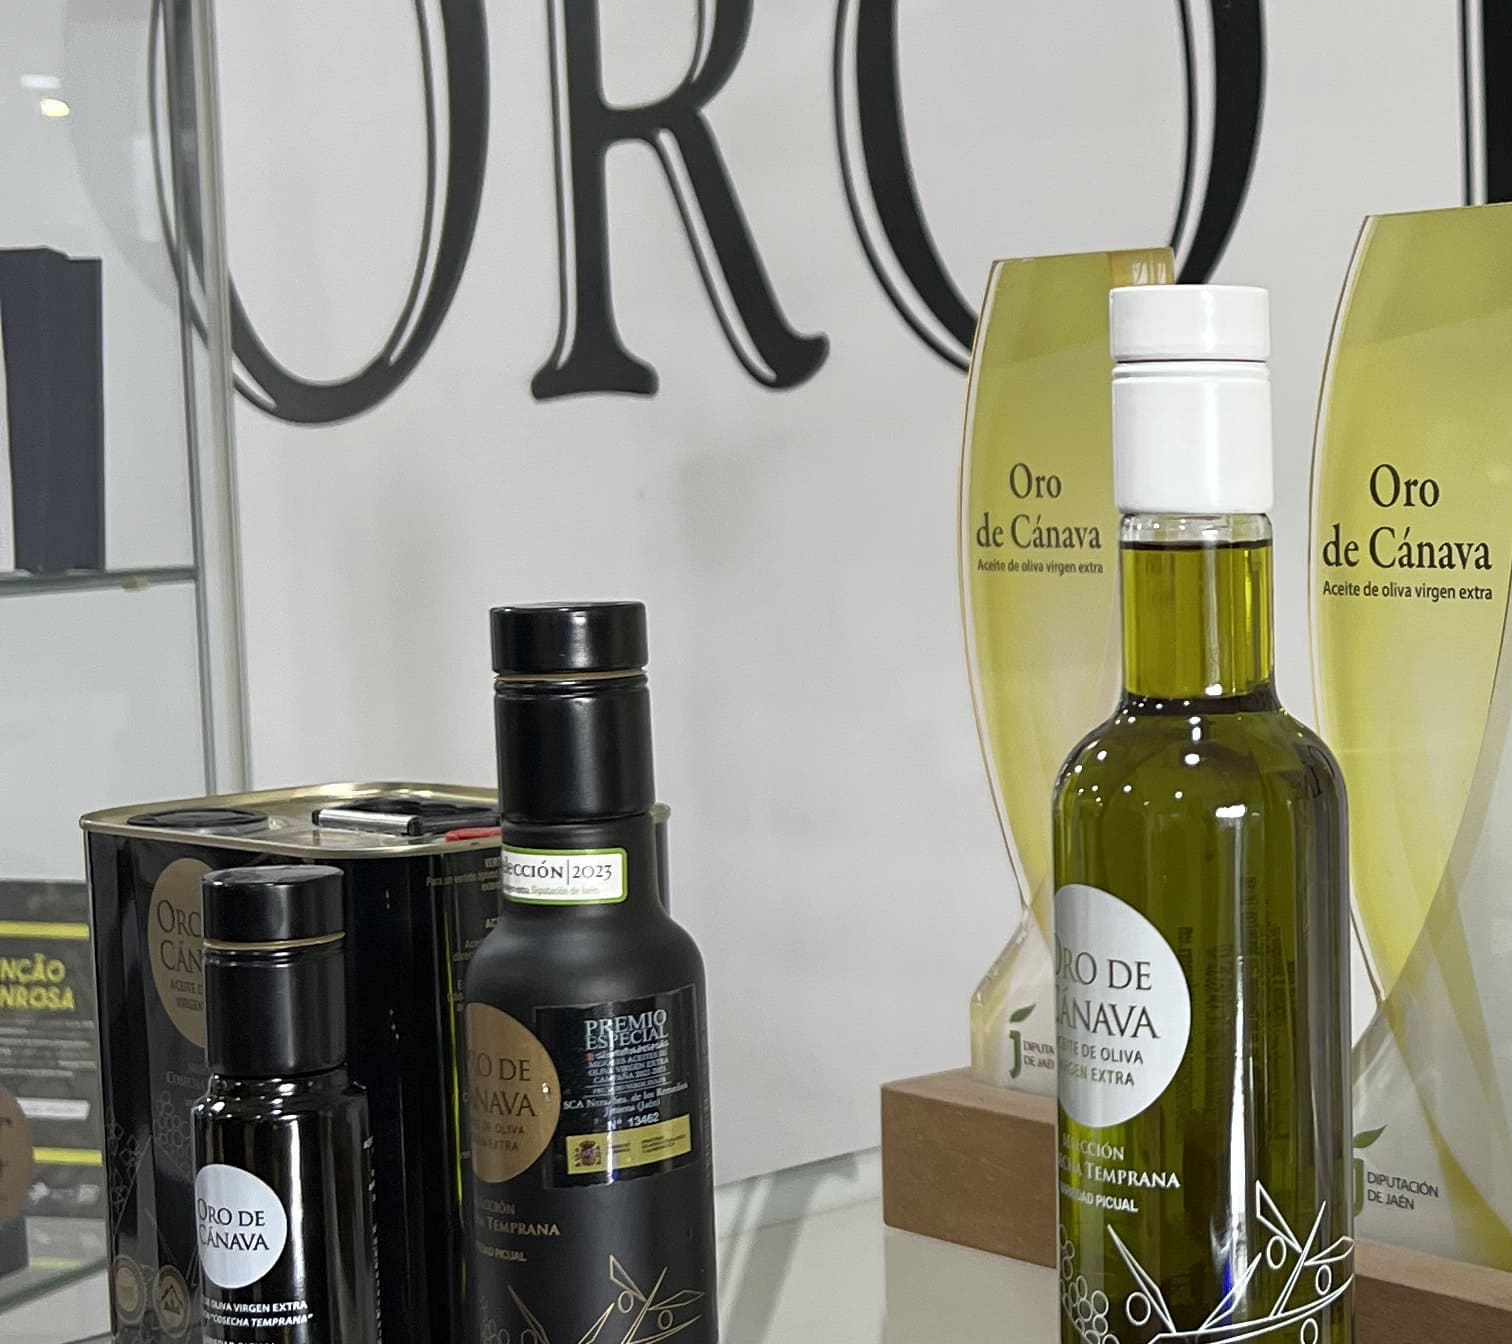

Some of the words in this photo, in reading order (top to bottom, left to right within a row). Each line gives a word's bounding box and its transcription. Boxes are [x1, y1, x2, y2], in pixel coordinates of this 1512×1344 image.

[1009, 462, 1062, 499] Oro
[1369, 463, 1440, 508] Oro
[976, 512, 1004, 548] de
[1011, 513, 1102, 549] Cánava
[1322, 522, 1360, 568] de
[1369, 526, 1493, 571] Cánava
[978, 558, 1006, 572] Aceite
[1008, 559, 1019, 572] de
[1021, 560, 1044, 573] oliva
[1046, 560, 1076, 577] virgen
[1078, 562, 1103, 574] extra
[1323, 580, 1360, 597] Aceite
[1363, 581, 1379, 597] de
[1381, 581, 1412, 598] oliva
[1414, 582, 1456, 603] virgen
[1459, 585, 1493, 600] extra
[1107, 959, 1153, 991] DE
[584, 1009, 667, 1037] PREMIO
[585, 1026, 669, 1051] ESPECIAL
[1081, 1043, 1097, 1060] DE
[1100, 1047, 1144, 1065] OLIVA
[500, 1058, 531, 1082] DE
[1090, 1068, 1135, 1087] EXTRA
[1085, 1161, 1181, 1189] TEMPRANA
[1367, 1171, 1440, 1198] DIPUTACIÓN
[197, 1198, 232, 1227] ORO
[238, 1210, 266, 1227] DE
[1095, 1194, 1139, 1213] PICUAL
[1367, 1189, 1382, 1205] DE
[1384, 1193, 1415, 1211] JAÉN
[199, 1222, 270, 1251] CÁNAVA
[233, 1302, 270, 1313] VIRGEN
[272, 1300, 308, 1311] EXTRA
